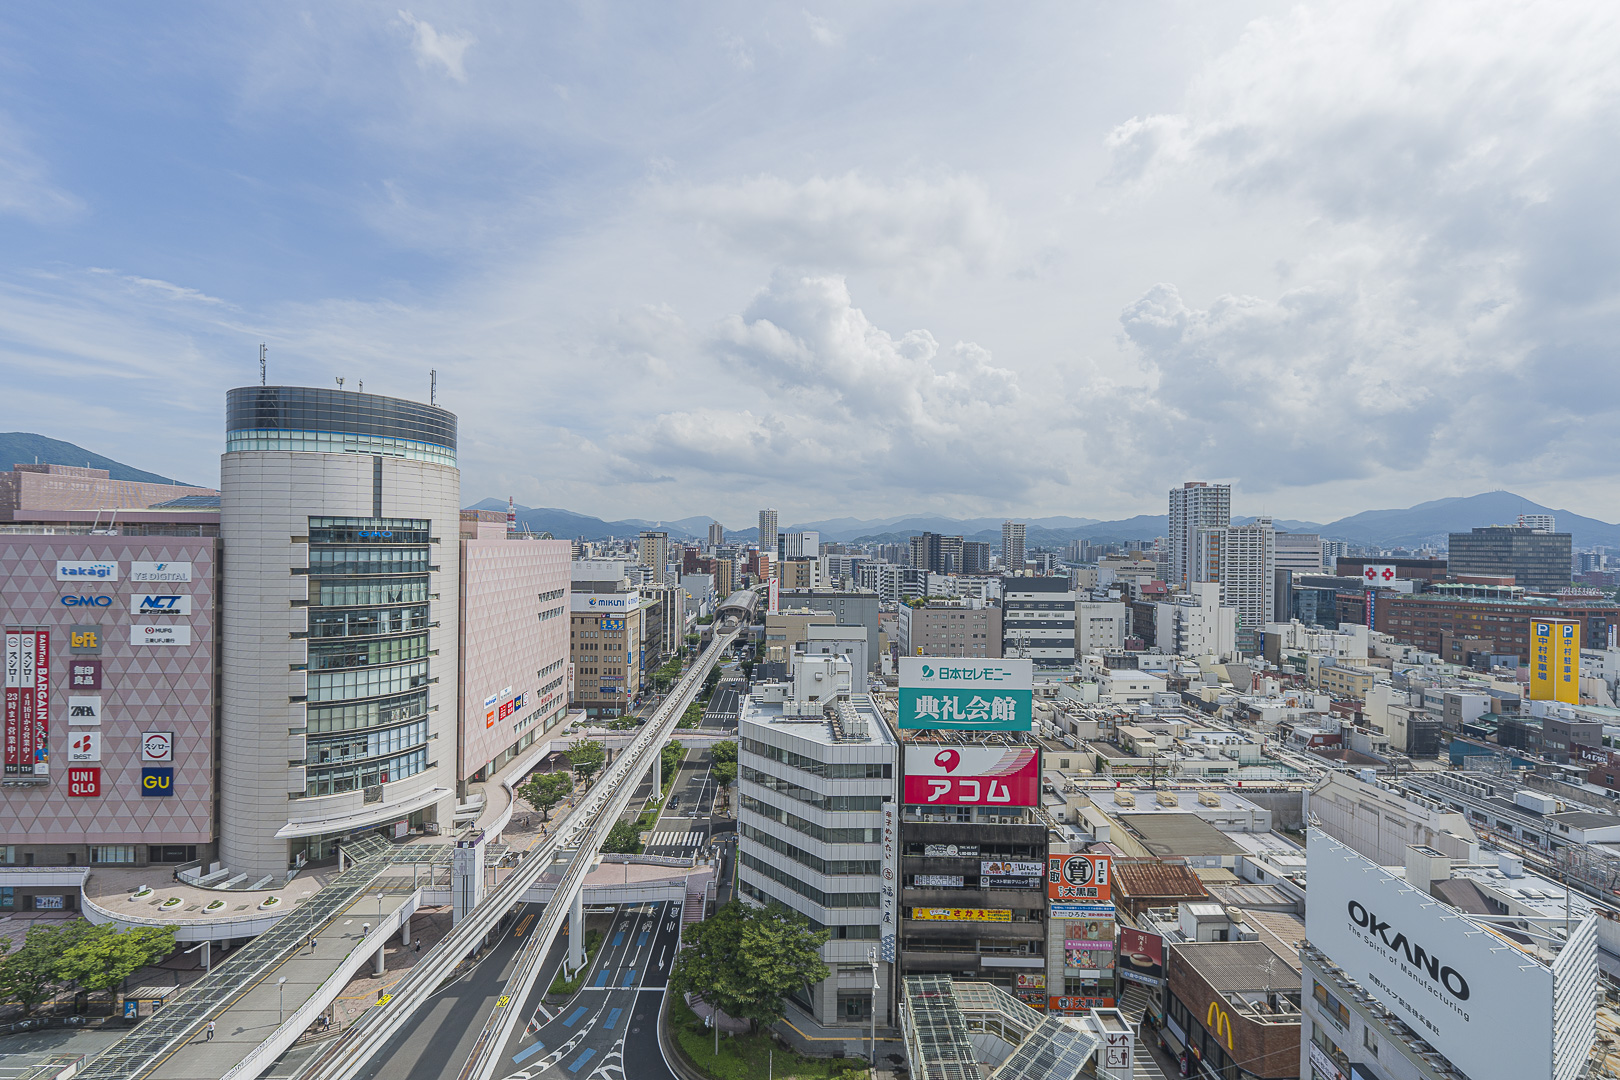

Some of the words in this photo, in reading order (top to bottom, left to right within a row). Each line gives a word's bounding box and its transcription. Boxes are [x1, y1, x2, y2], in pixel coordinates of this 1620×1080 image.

[358, 530, 393, 538] GMO
[61, 565, 111, 577] takagi
[134, 573, 148, 581] YE
[150, 573, 188, 581] DIGITAL
[61, 595, 113, 607] GMO
[1538, 637, 1548, 680] 中村駐車場
[1563, 639, 1572, 682] 中村駐車場
[8, 652, 18, 683] スシロー
[23, 652, 33, 683] スシロー
[74, 666, 94, 675] 無印
[939, 667, 1012, 681] 日本セレモニー
[74, 675, 94, 685] 良品
[37, 668, 47, 720] BARGAIN
[70, 706, 96, 717] ZARA
[914, 695, 1017, 721] 典礼会館
[72, 772, 93, 781] UNI
[143, 775, 170, 789] GU
[72, 783, 95, 794] QLO
[927, 779, 1011, 802] アコム
[1049, 859, 1061, 883] 買取
[1068, 861, 1088, 884] 質
[1064, 886, 1098, 897] 大黒屋
[953, 909, 985, 918] さかえ
[514, 914, 535, 937] 40
[1348, 900, 1470, 1001] OKANO
[1348, 923, 1361, 938] The
[1363, 936, 1386, 957] Spirit
[1389, 955, 1398, 966] of
[1401, 962, 1470, 1022] Manufacturing
